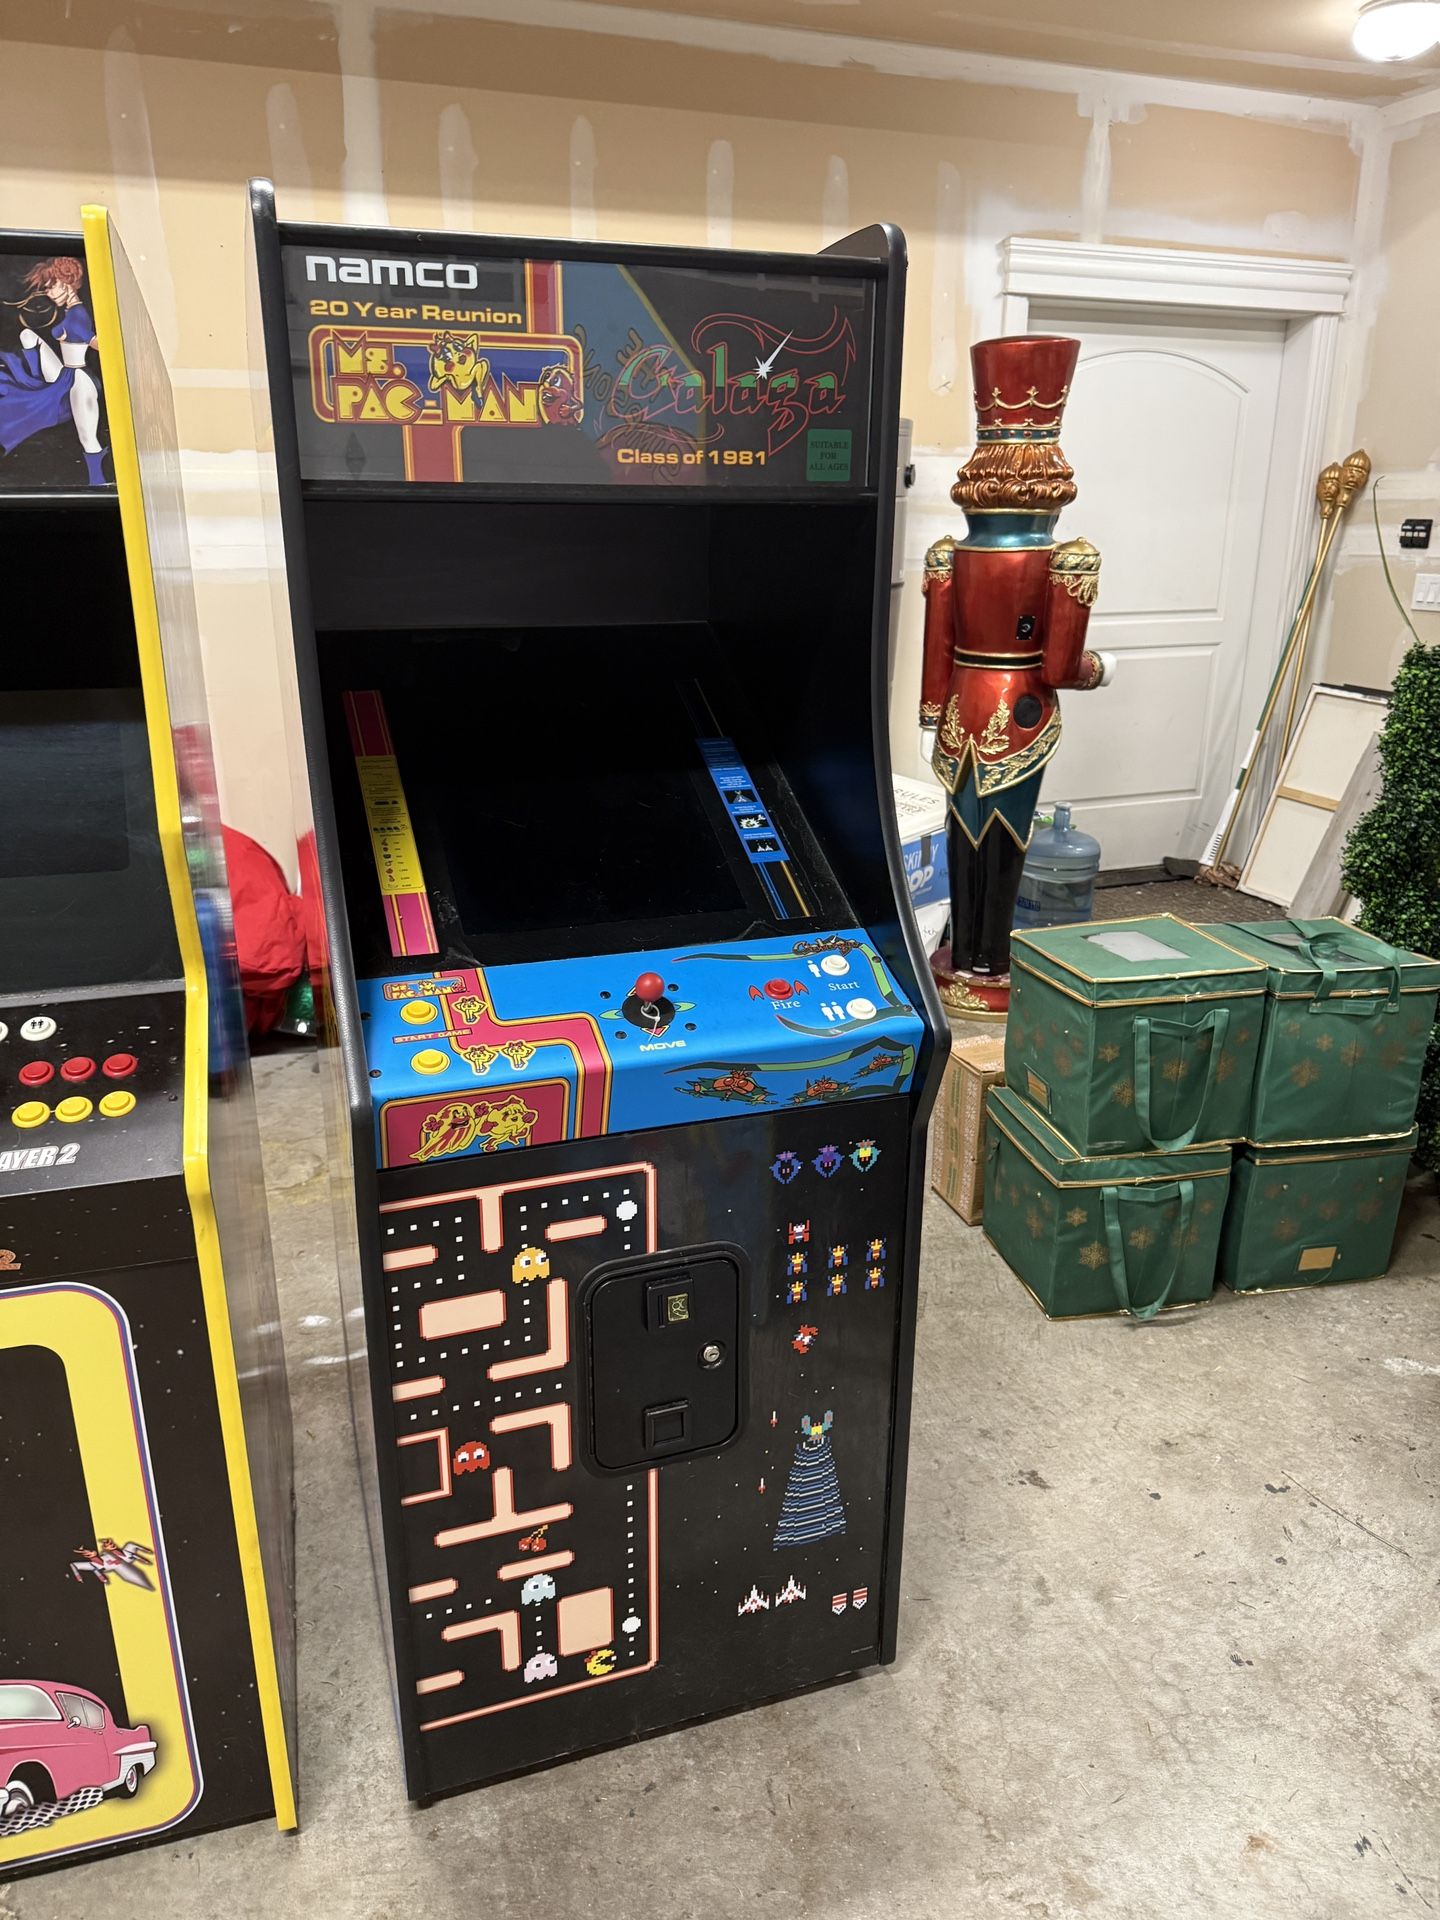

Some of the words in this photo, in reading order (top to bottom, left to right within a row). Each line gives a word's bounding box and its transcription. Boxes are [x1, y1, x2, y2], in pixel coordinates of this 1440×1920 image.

[305, 255, 479, 290] namco
[309, 300, 349, 317] 20
[352, 301, 418, 320] Year
[421, 304, 523, 325] Reunion
[611, 339, 847, 457] Galaga
[810, 440, 849, 450] SUITABLE
[616, 448, 679, 466] Class
[682, 450, 704, 466] of
[708, 450, 767, 466] 1981
[819, 451, 838, 460] FOR
[809, 462, 825, 471] ALL
[828, 462, 849, 471] AGES
[907, 865, 935, 893] OP
[828, 981, 861, 992] Start
[771, 1000, 801, 1011] Fire
[394, 1033, 435, 1044] START
[437, 1028, 472, 1039] GAME
[639, 1039, 688, 1052] MOVE
